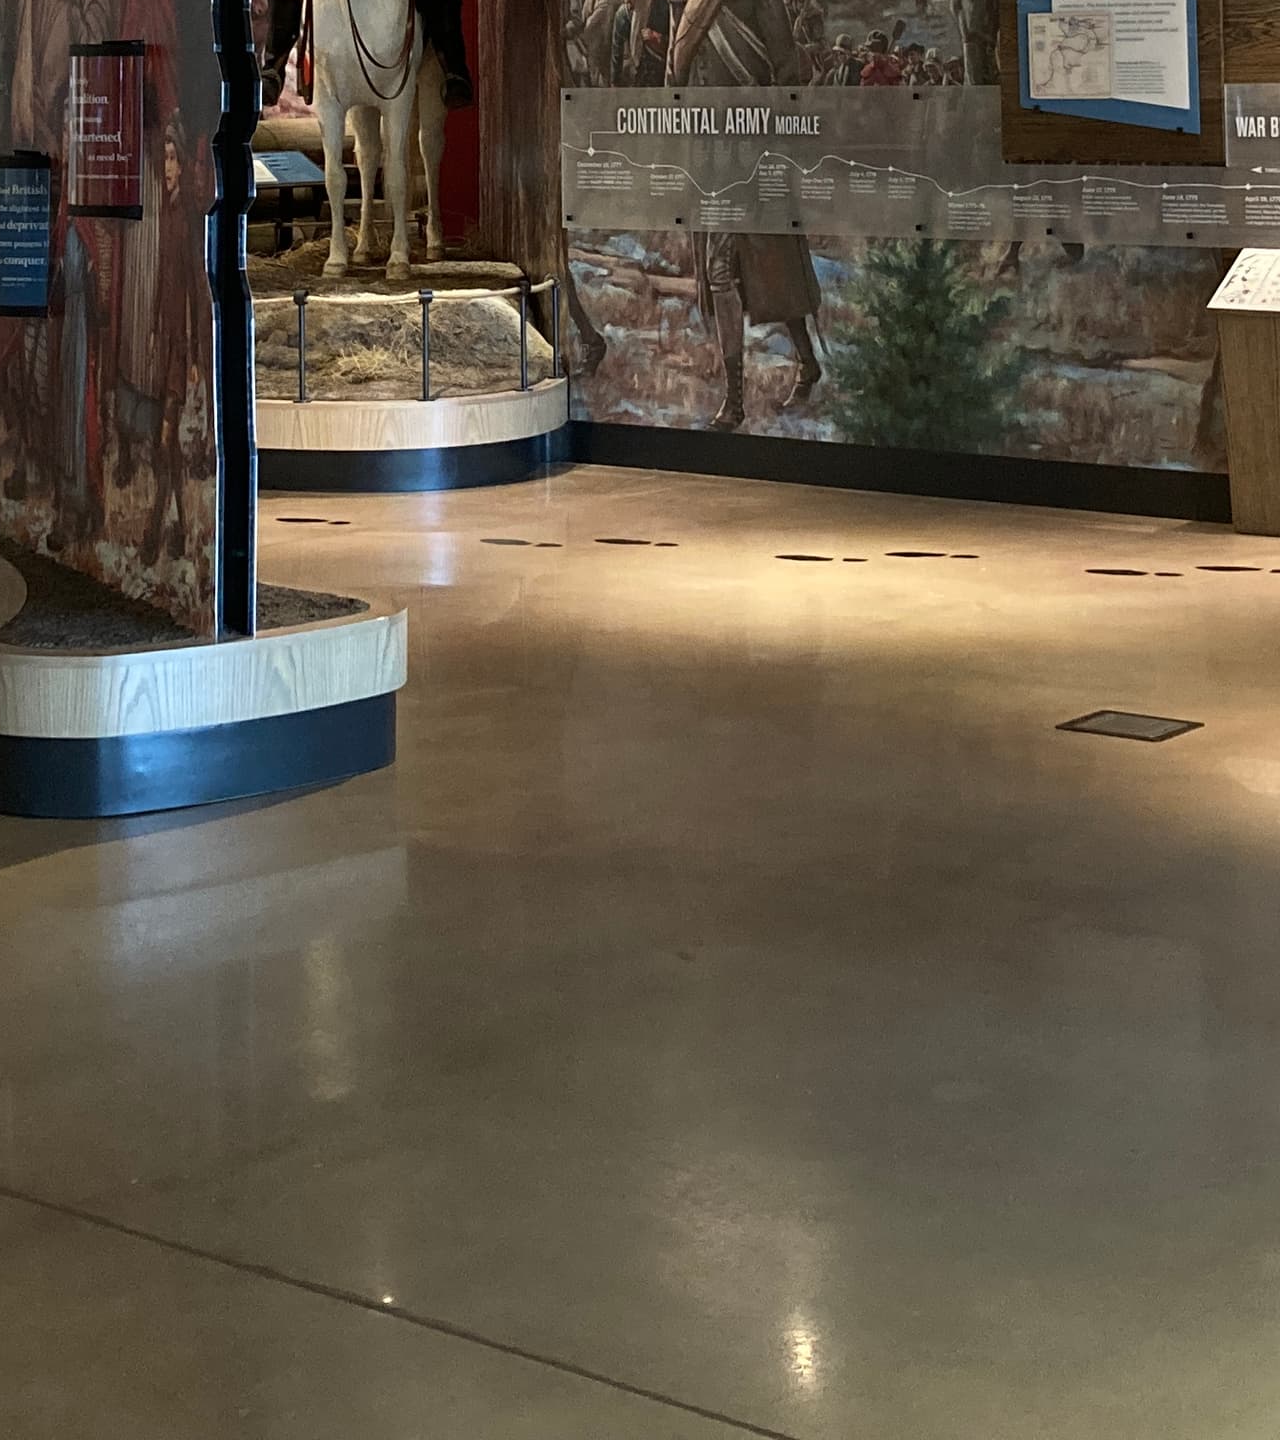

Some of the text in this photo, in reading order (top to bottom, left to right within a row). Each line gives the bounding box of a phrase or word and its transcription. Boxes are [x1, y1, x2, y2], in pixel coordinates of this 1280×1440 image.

[616, 107, 820, 135] CONTINENTAL ARMY MORALE
[1235, 116, 1266, 138] WAR
